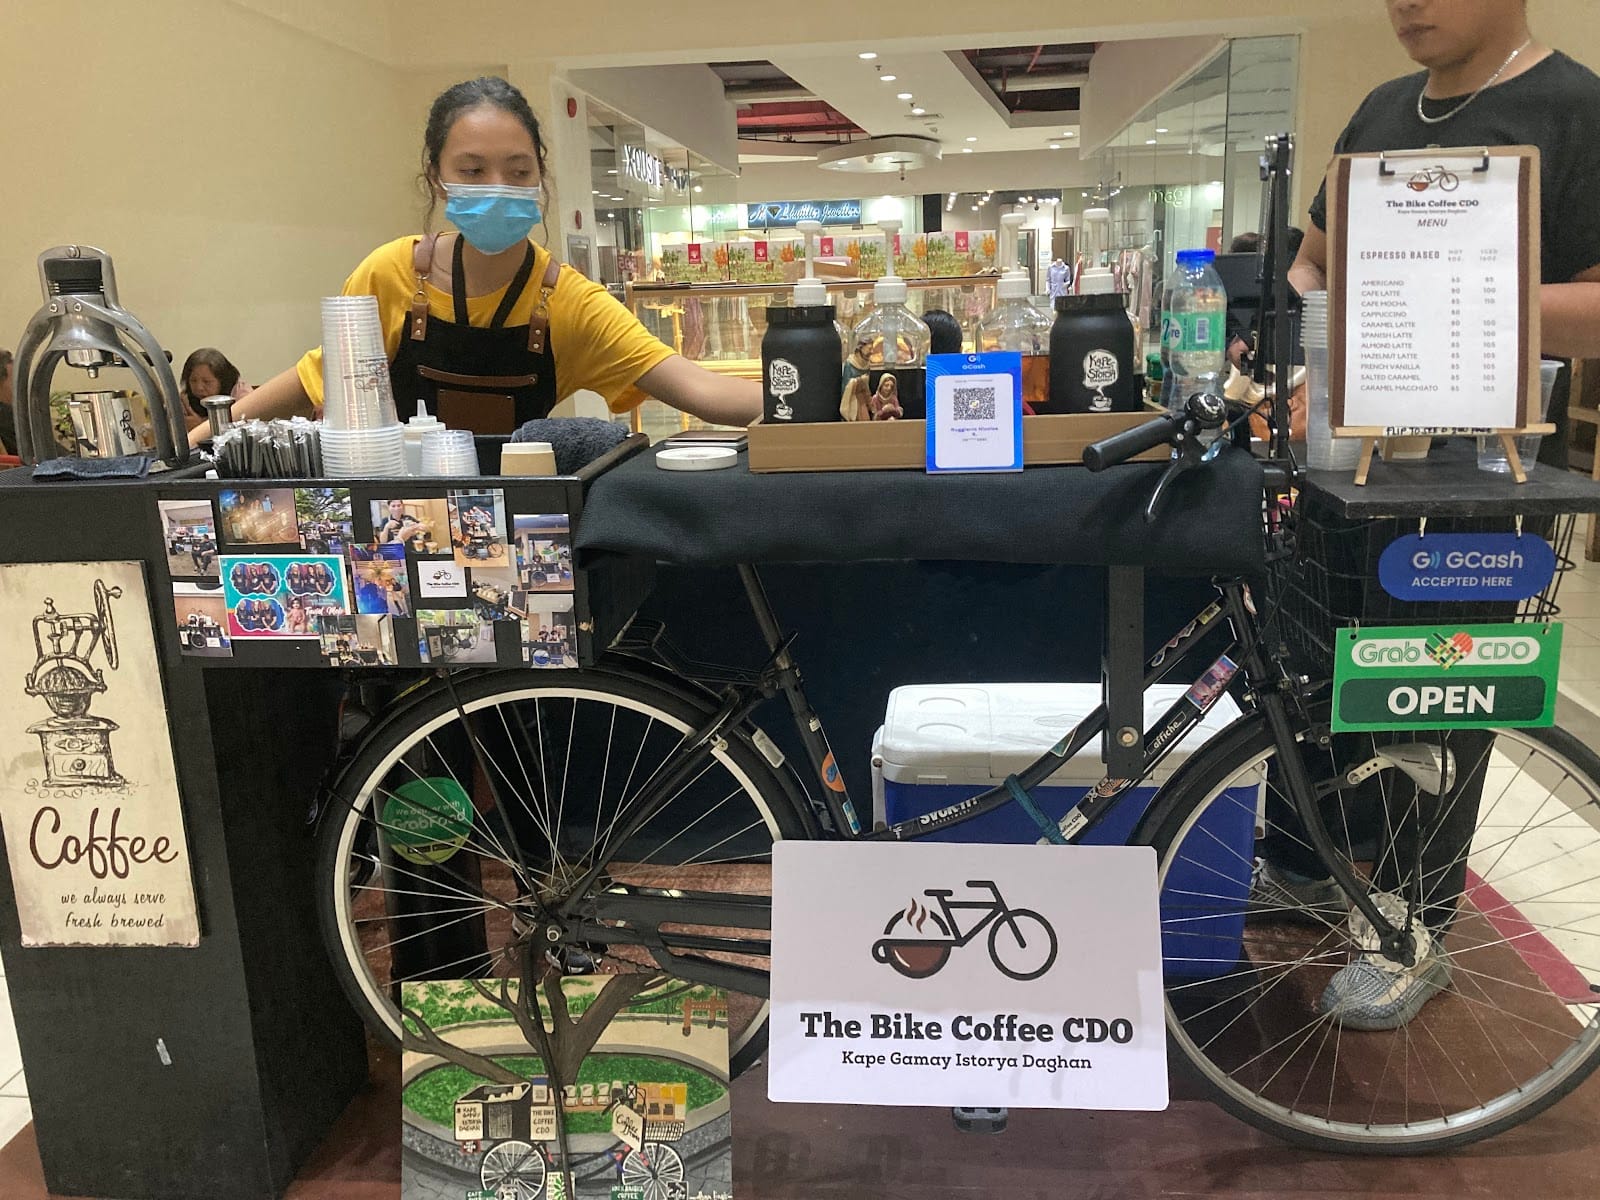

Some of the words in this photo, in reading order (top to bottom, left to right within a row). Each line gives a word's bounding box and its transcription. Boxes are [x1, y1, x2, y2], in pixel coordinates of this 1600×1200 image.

[1417, 219, 1448, 227] MENU
[1360, 251, 1406, 260] ESPRESSO
[1410, 251, 1440, 260] BASED
[1446, 551, 1524, 569] GCash
[1412, 576, 1478, 587] ACCEPTED
[1482, 576, 1513, 587] HERE
[1358, 641, 1421, 663] Grab
[1478, 641, 1530, 660] CDO
[1387, 685, 1496, 715] OPEN
[29, 806, 179, 879] Coffee
[61, 893, 77, 904] we
[84, 886, 127, 908] always
[134, 893, 166, 904] serve
[66, 912, 103, 928] fresh
[110, 914, 164, 928] brewed
[800, 1011, 862, 1039] The
[870, 1012, 943, 1040] Bike
[951, 1014, 1054, 1043] Coffee
[1062, 1017, 1134, 1044] CDO
[842, 1051, 886, 1067] Kape
[890, 1052, 952, 1070] Gamay
[956, 1053, 1018, 1072] Istorya
[1022, 1054, 1092, 1073] Daghan
